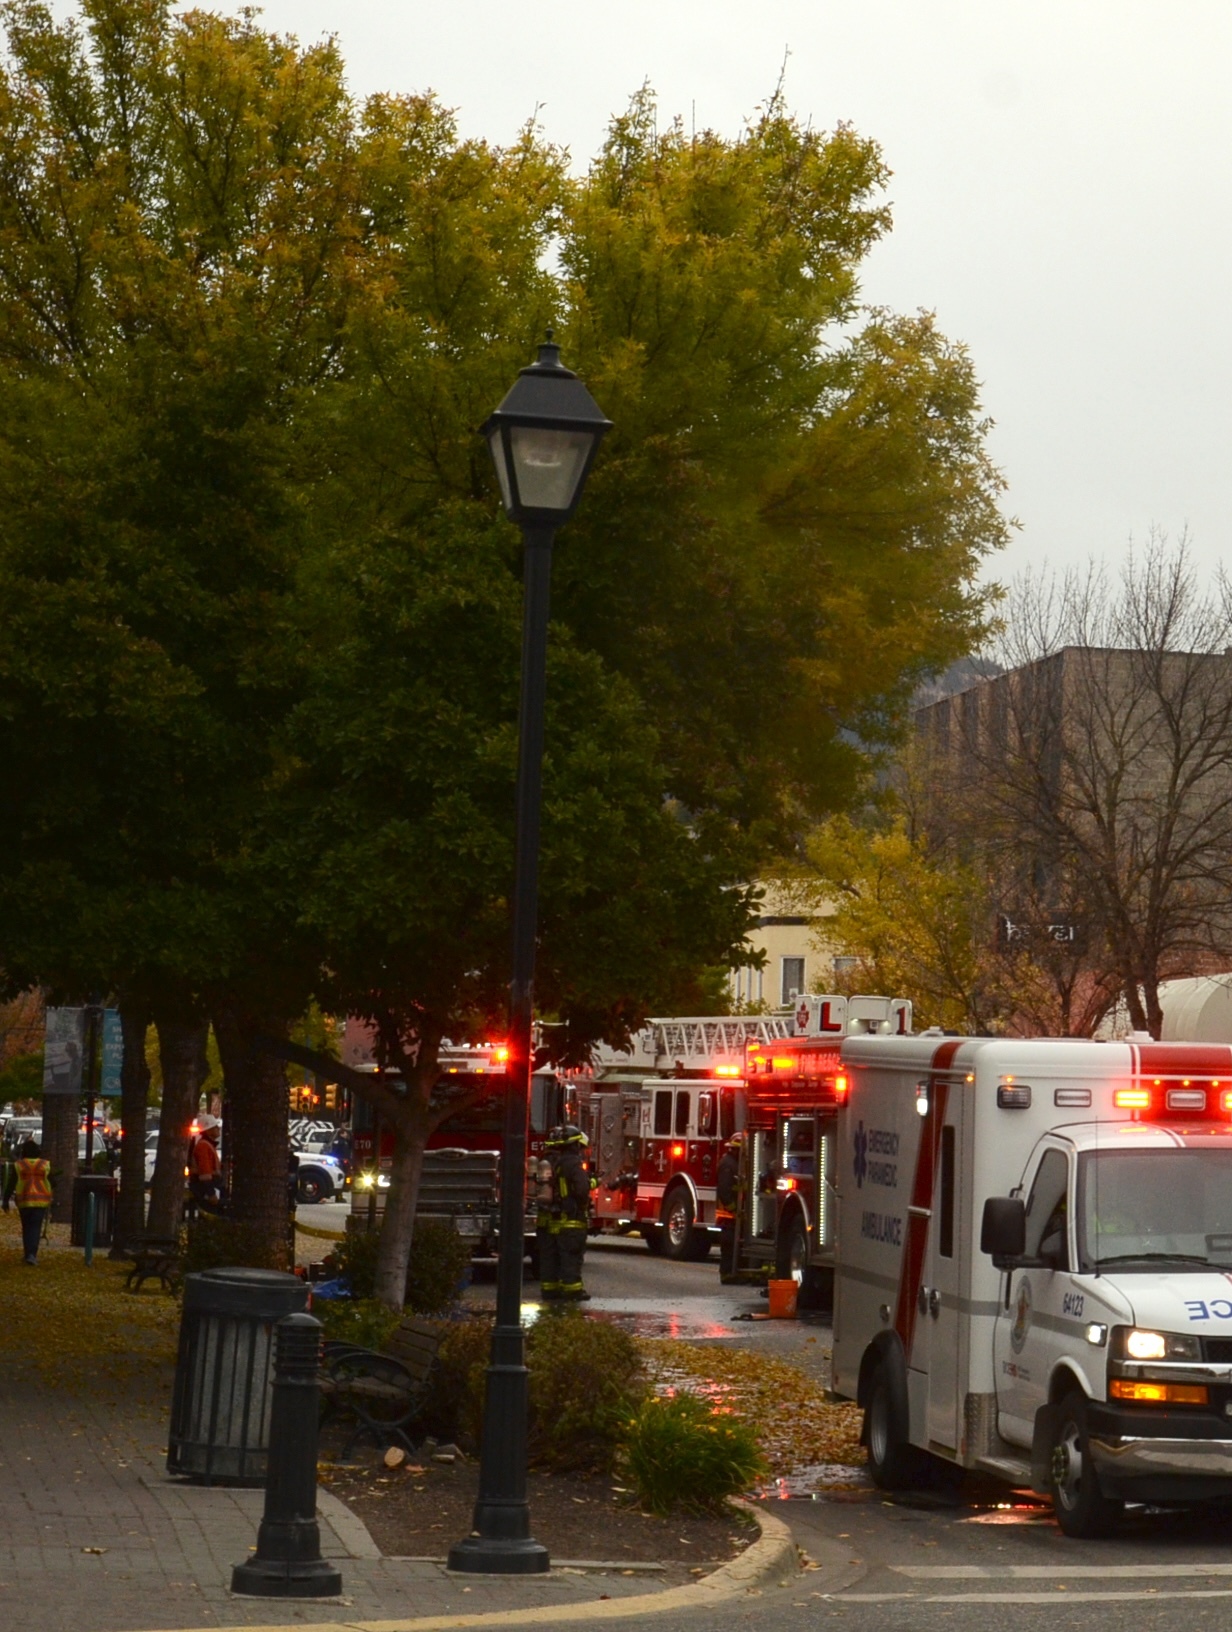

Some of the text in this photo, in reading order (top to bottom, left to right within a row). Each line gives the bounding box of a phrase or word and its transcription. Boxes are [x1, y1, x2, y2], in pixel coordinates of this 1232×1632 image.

[820, 1002, 842, 1032] L
[531, 1141, 545, 1150] E7
[868, 1129, 899, 1157] EMERGENCY
[867, 1160, 898, 1189] PARAMEDIC
[861, 1210, 902, 1247] AMBULANCE
[1063, 1292, 1085, 1318] 64123
